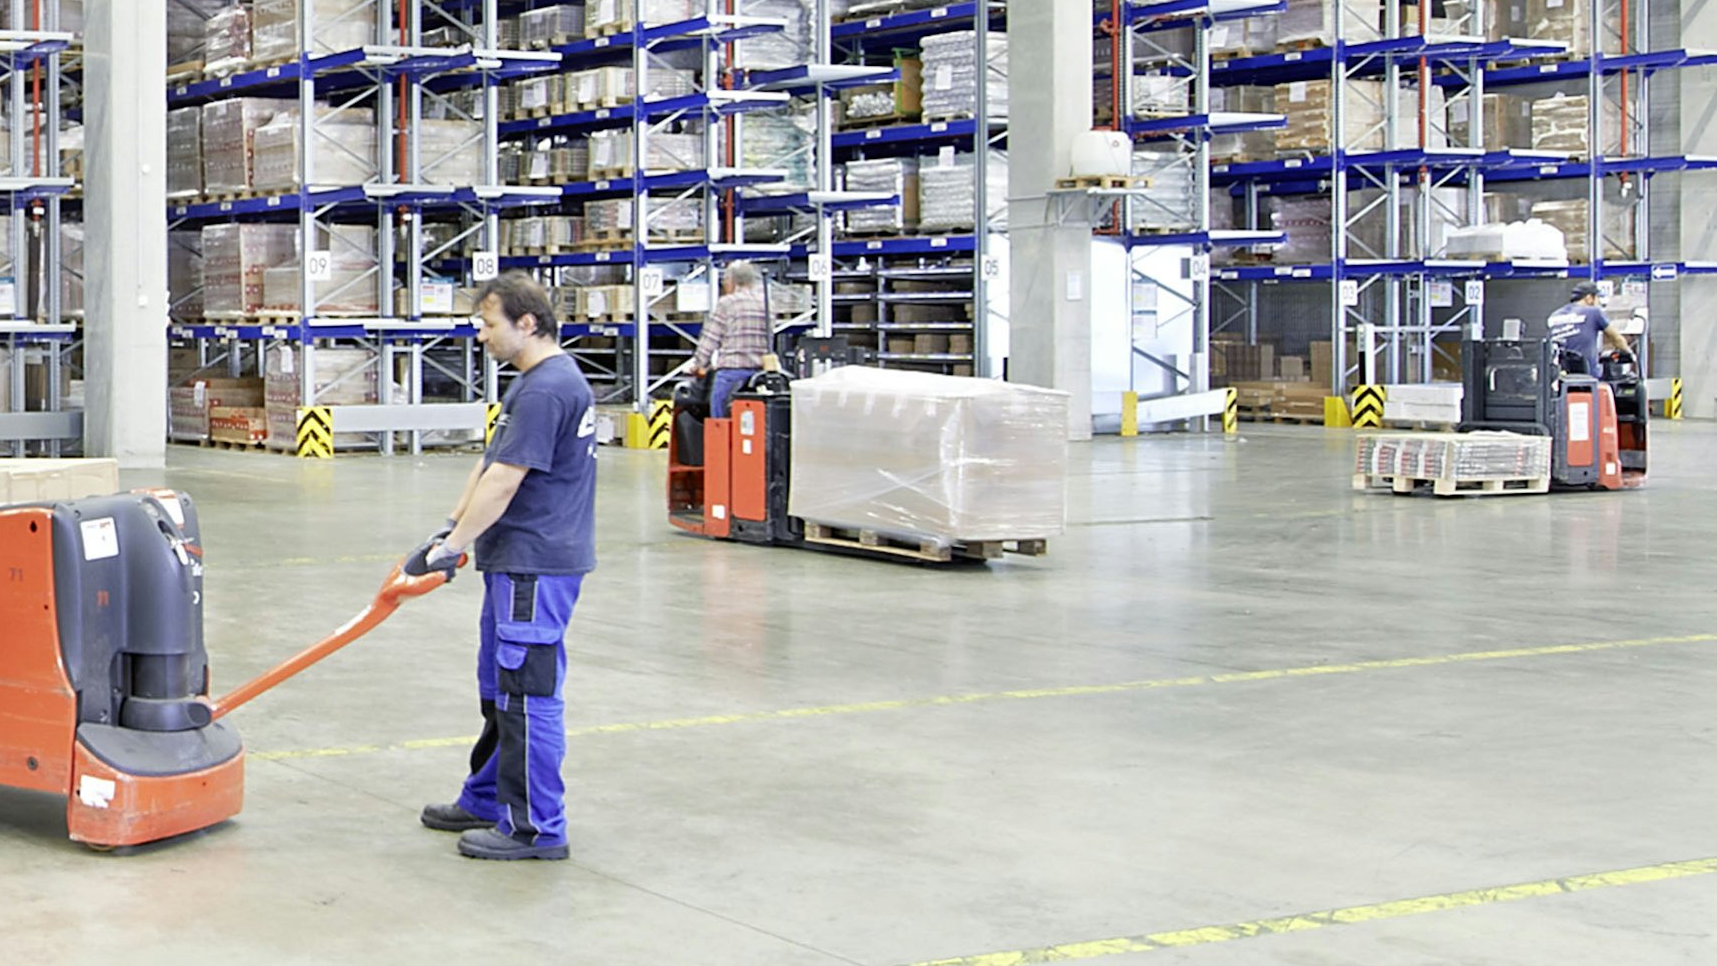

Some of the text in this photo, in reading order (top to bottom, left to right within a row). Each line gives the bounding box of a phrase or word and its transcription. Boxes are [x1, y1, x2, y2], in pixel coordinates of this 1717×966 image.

[309, 257, 328, 275] 09
[476, 258, 494, 275] 08
[812, 259, 828, 276] 06
[984, 259, 999, 276] 05
[1192, 260, 1207, 276] 04
[642, 273, 660, 291] 07
[1468, 286, 1481, 300] 02
